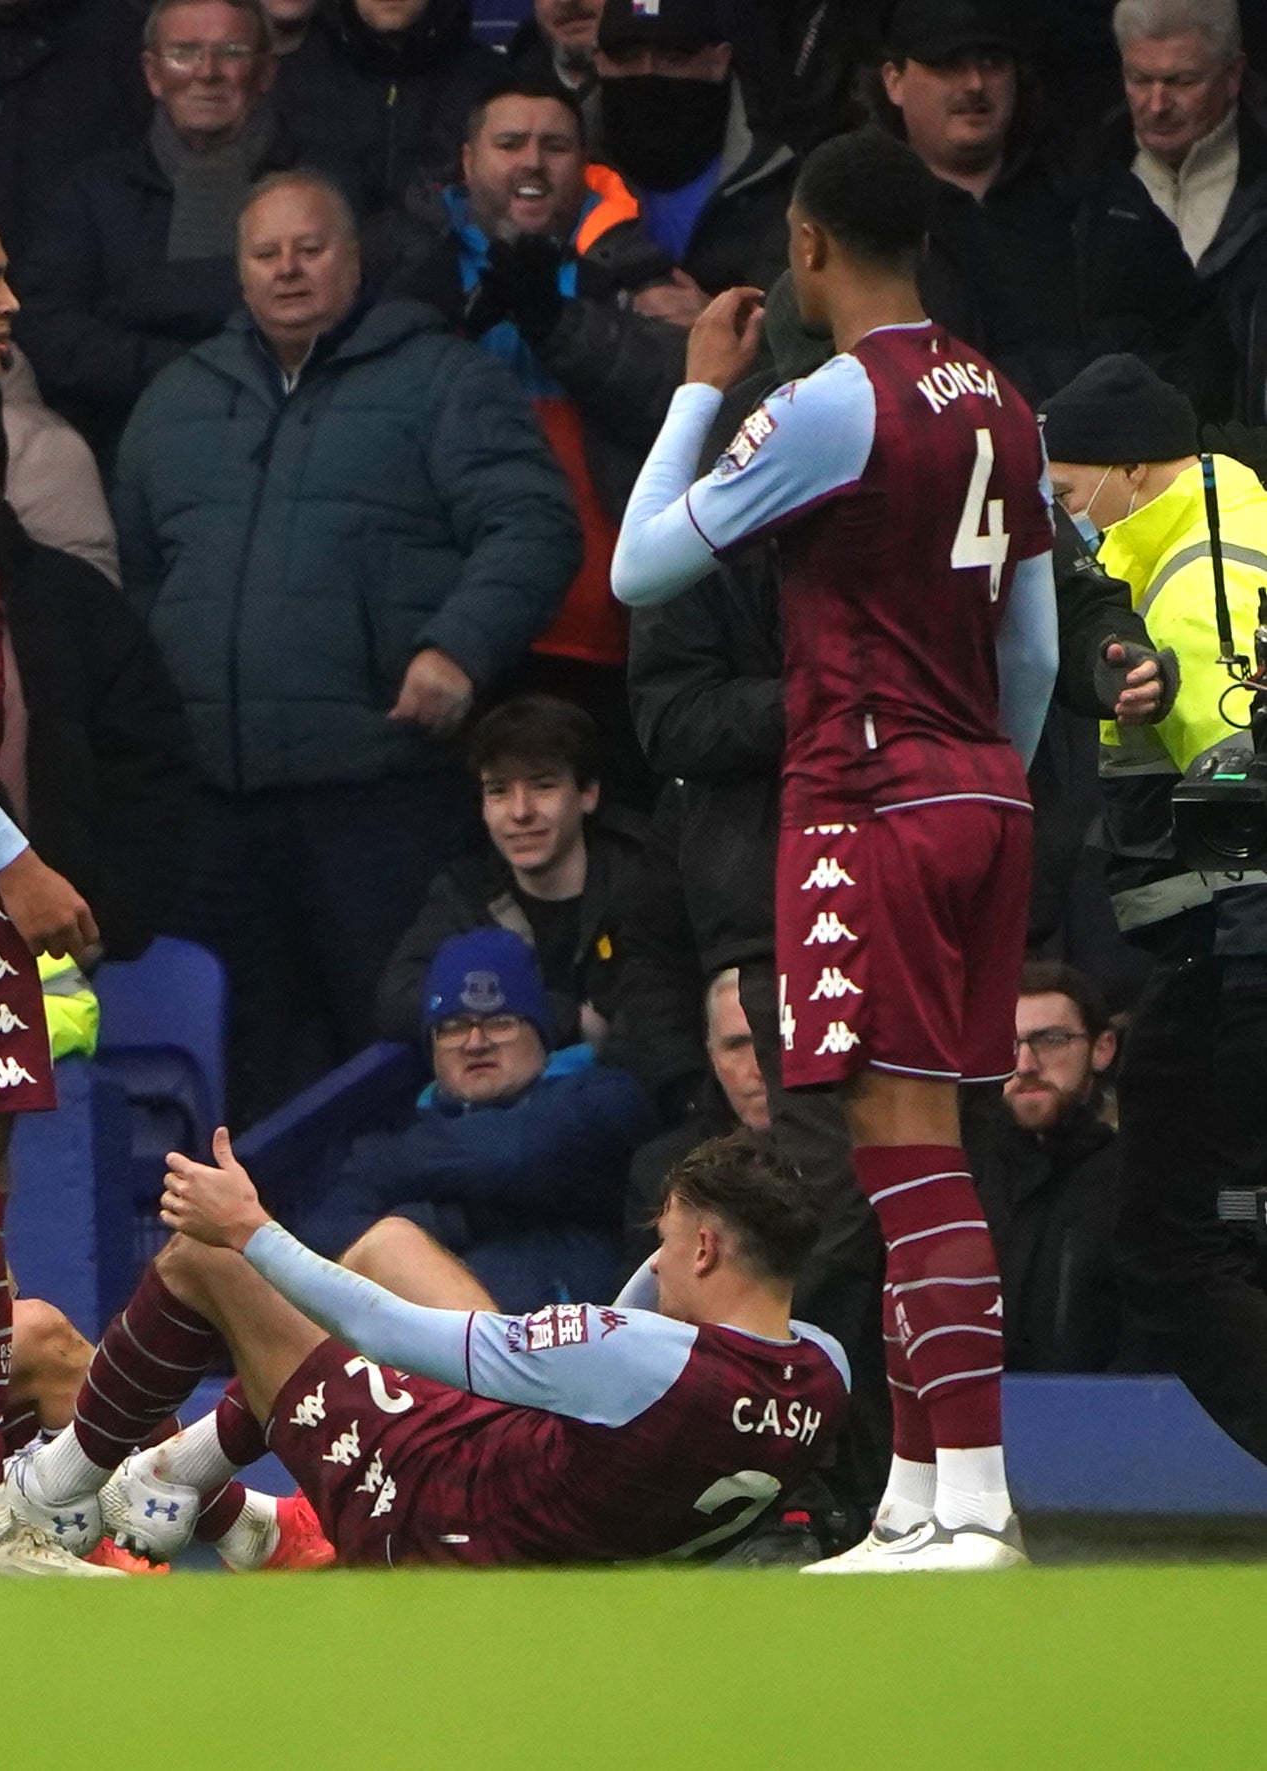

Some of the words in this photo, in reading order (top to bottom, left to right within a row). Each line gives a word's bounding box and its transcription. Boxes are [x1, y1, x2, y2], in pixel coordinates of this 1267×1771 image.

[917, 362, 1002, 414] KONSA
[951, 428, 1010, 603] 4
[344, 1354, 414, 1414] 2
[732, 1397, 822, 1446] CASH
[663, 1469, 782, 1560] 2
